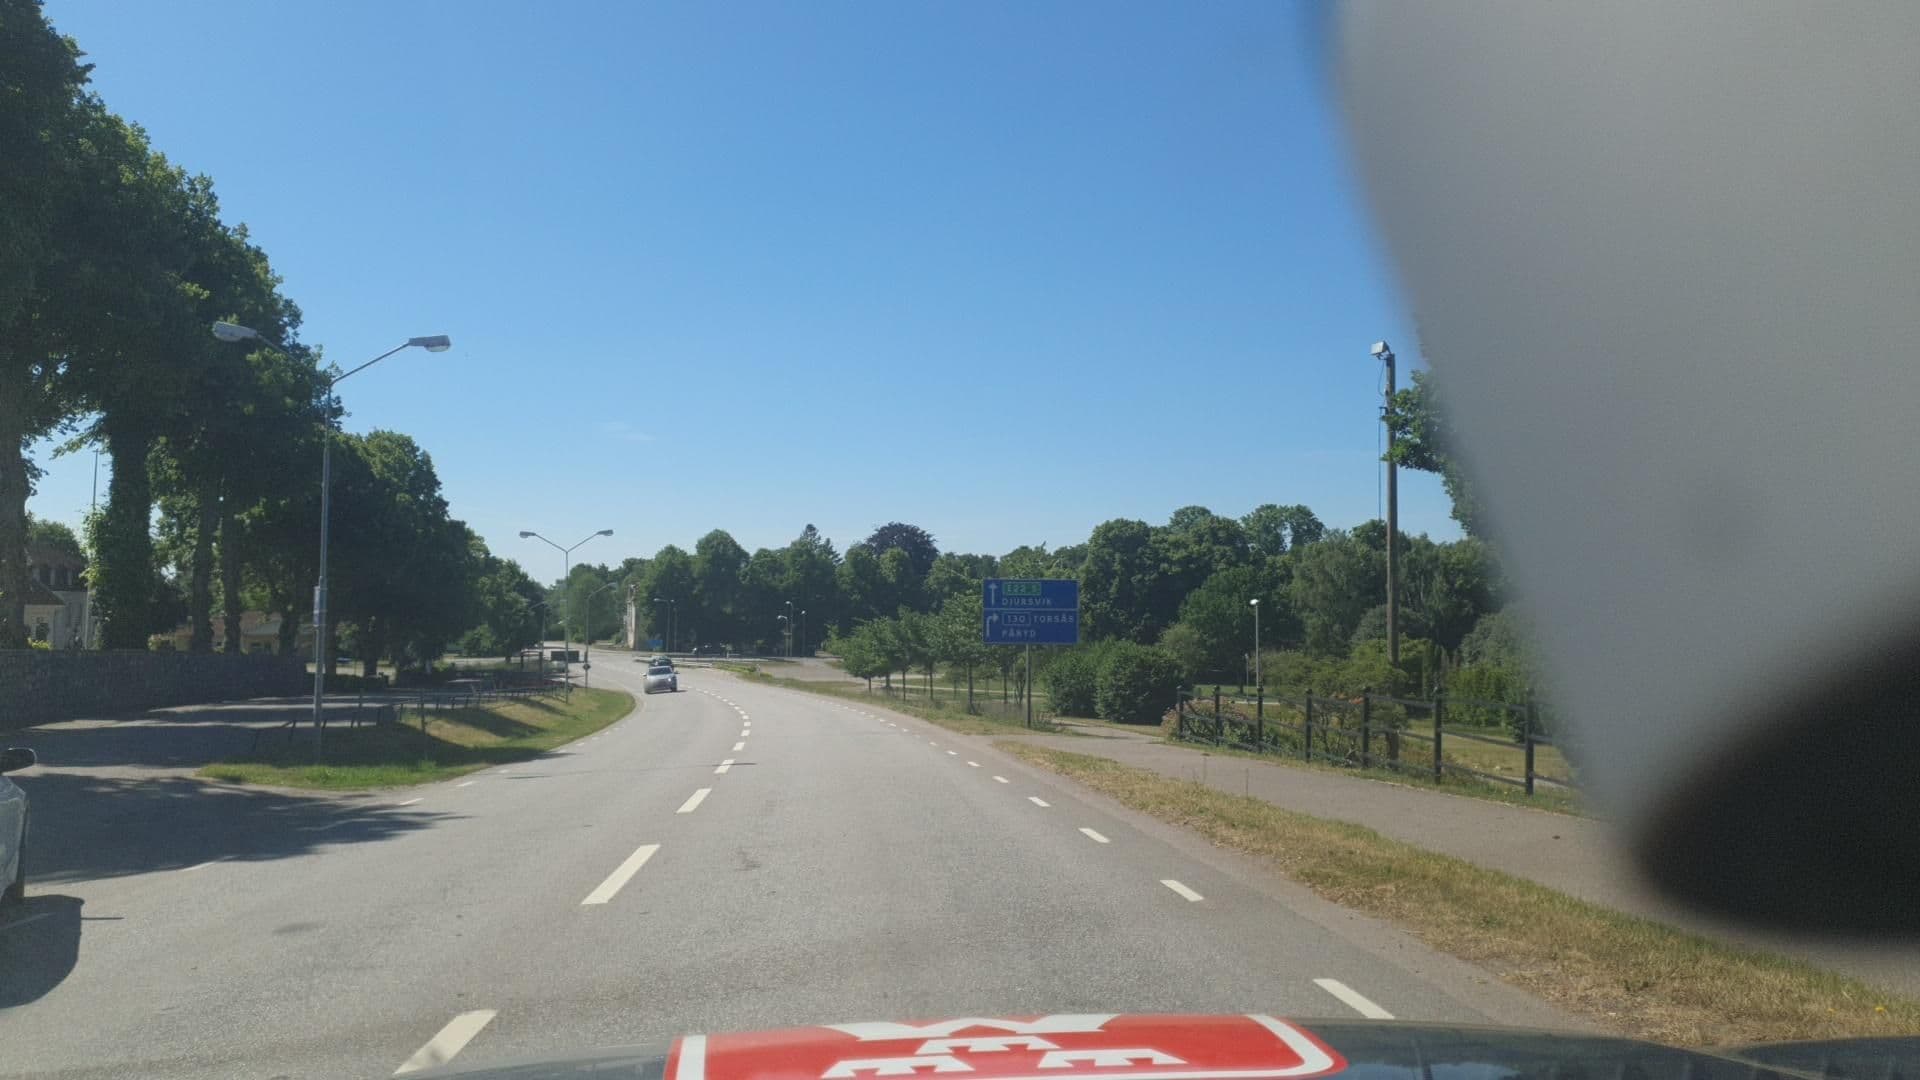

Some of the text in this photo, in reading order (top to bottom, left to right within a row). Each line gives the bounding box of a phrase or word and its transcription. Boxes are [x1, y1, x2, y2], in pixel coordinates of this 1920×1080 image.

[1007, 584, 1025, 593] E22
[1001, 598, 1052, 606] DJURSVIK
[1007, 613, 1074, 624] 130 TORSÅS
